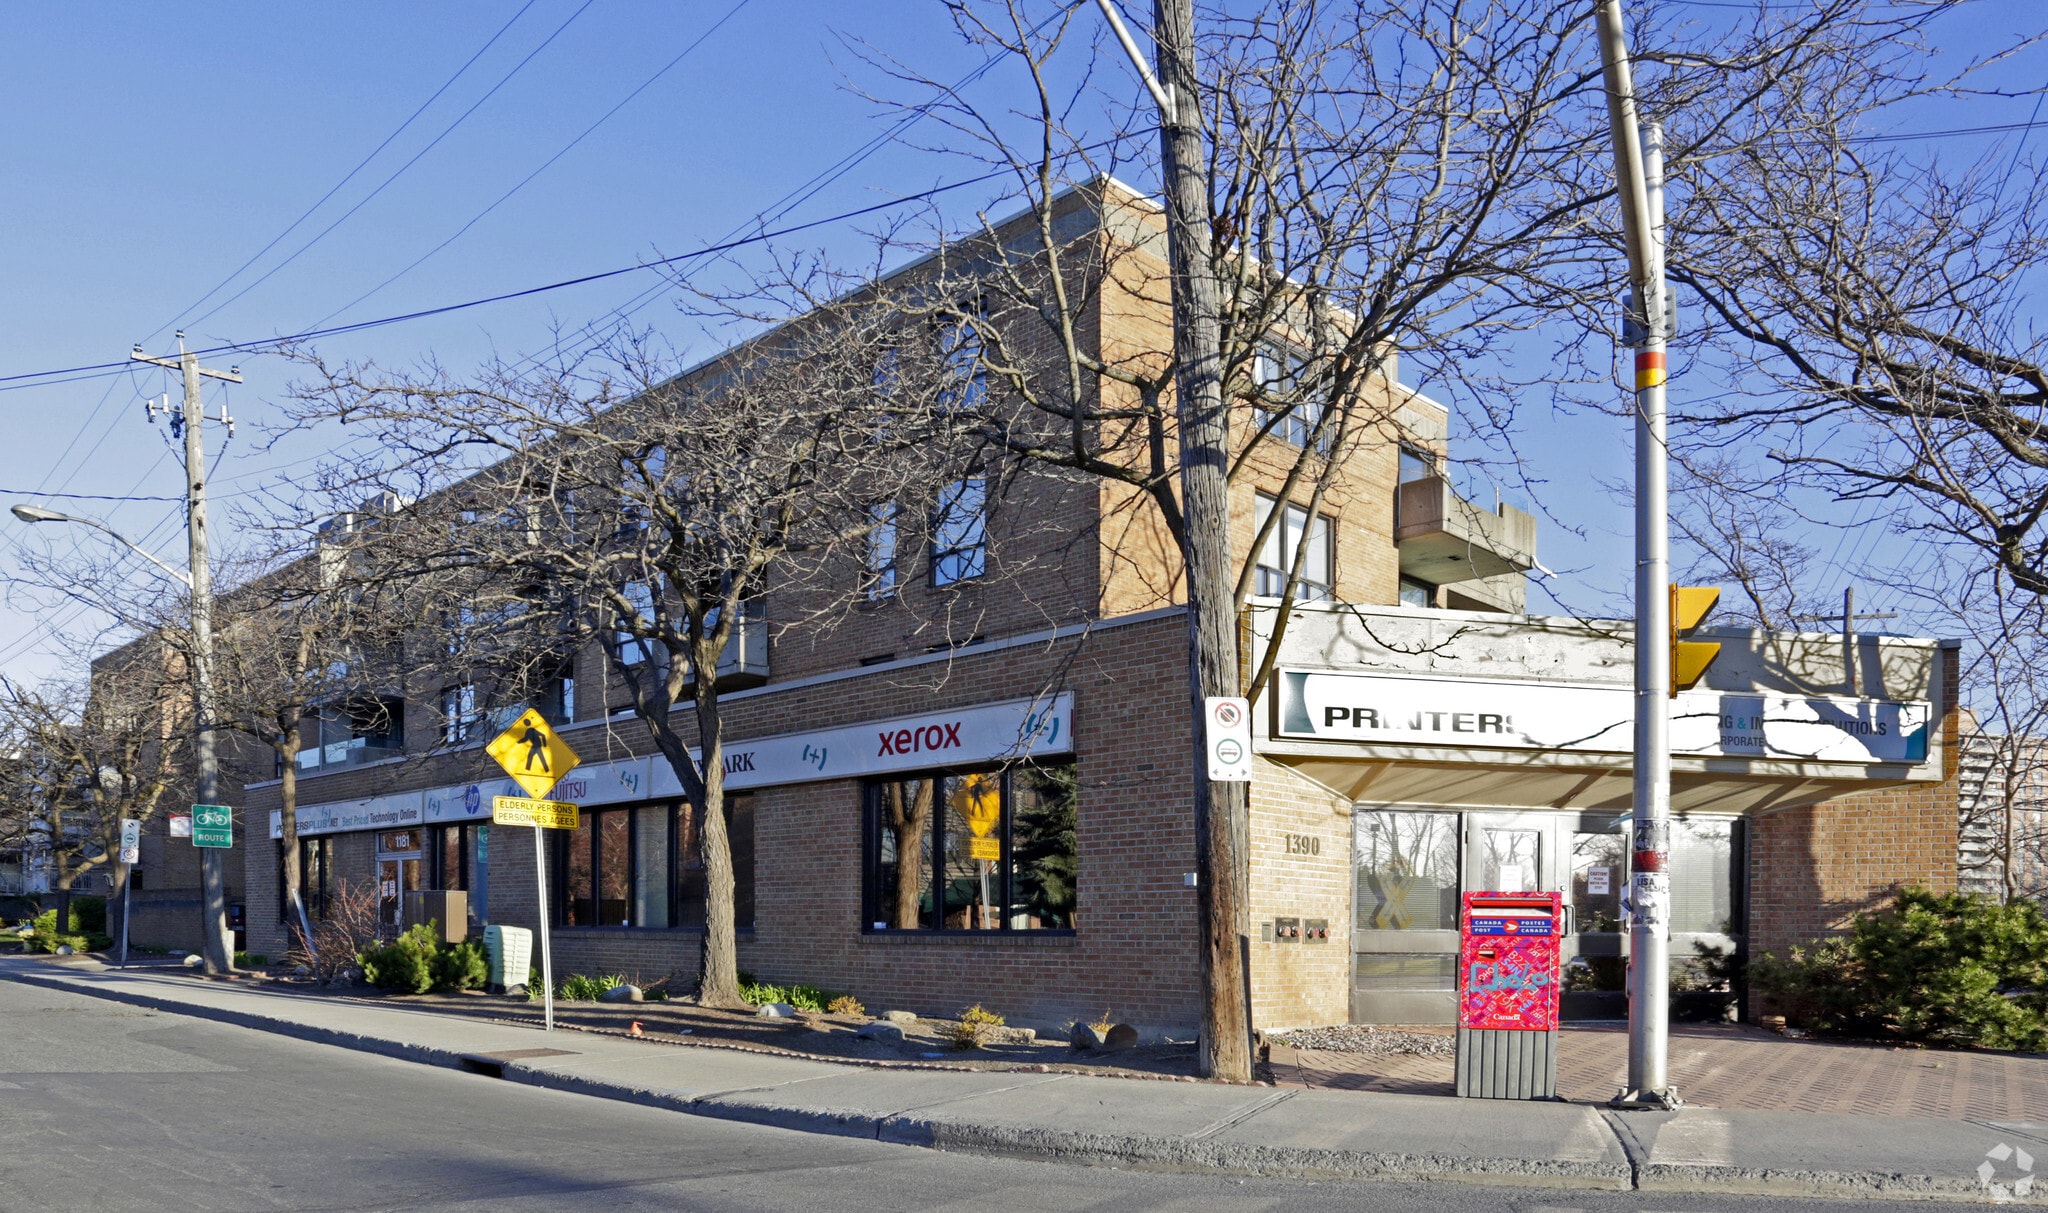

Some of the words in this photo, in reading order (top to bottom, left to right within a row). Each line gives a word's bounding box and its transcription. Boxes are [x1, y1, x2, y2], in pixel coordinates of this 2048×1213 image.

[1737, 717, 1746, 729] &
[878, 722, 961, 757] xerox
[500, 800, 534, 810] ELDERLY
[537, 803, 573, 814] PERSONS
[370, 811, 399, 824] Technology
[400, 808, 417, 820] Online
[499, 812, 547, 824] PERSONNES
[198, 834, 225, 842] ROUTE
[395, 834, 410, 848] 1181
[1285, 834, 1320, 856] 1390
